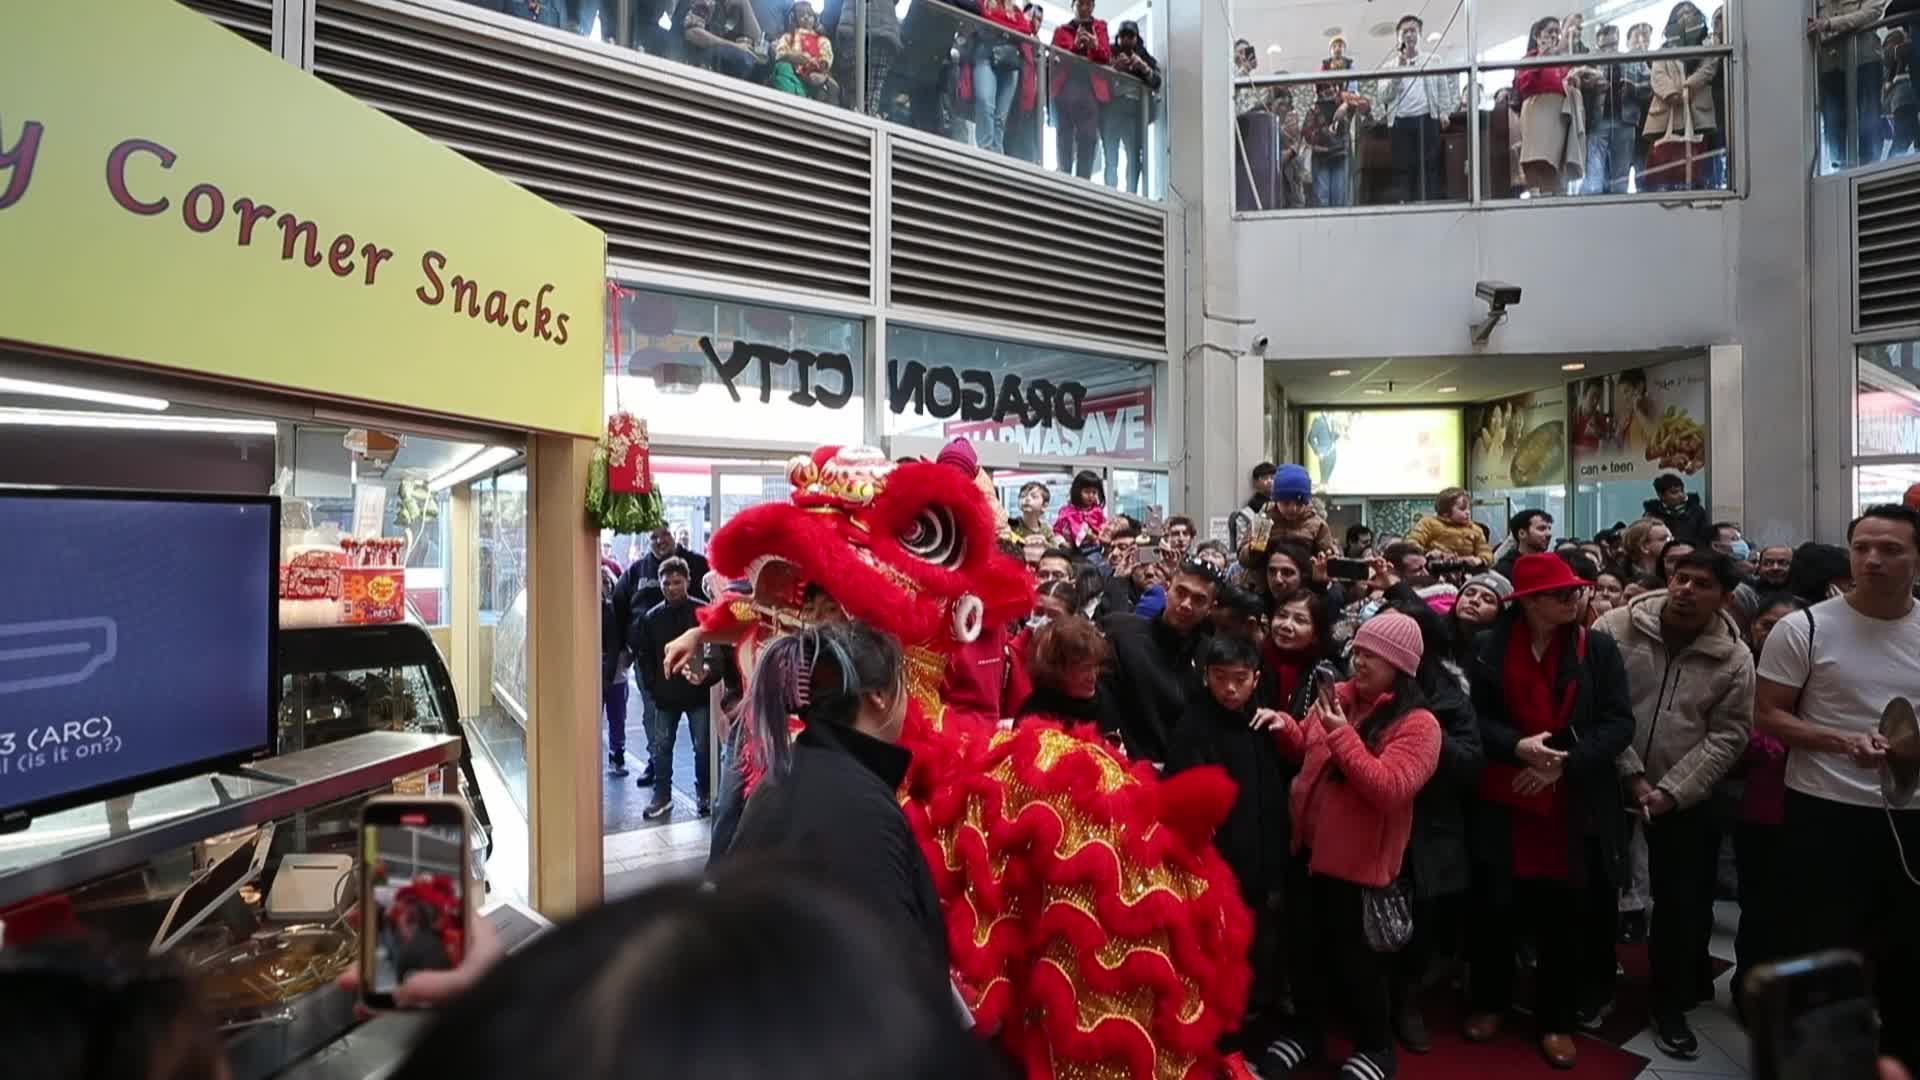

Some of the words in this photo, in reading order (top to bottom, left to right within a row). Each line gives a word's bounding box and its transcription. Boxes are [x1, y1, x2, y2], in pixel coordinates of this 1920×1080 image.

[105, 137, 393, 286] Corner
[416, 250, 570, 346] Snacks
[1580, 464, 1599, 476] can
[27, 716, 112, 751] (ARC)
[18, 752, 45, 772] (is
[54, 746, 68, 763] it
[76, 736, 122, 757] on?)
